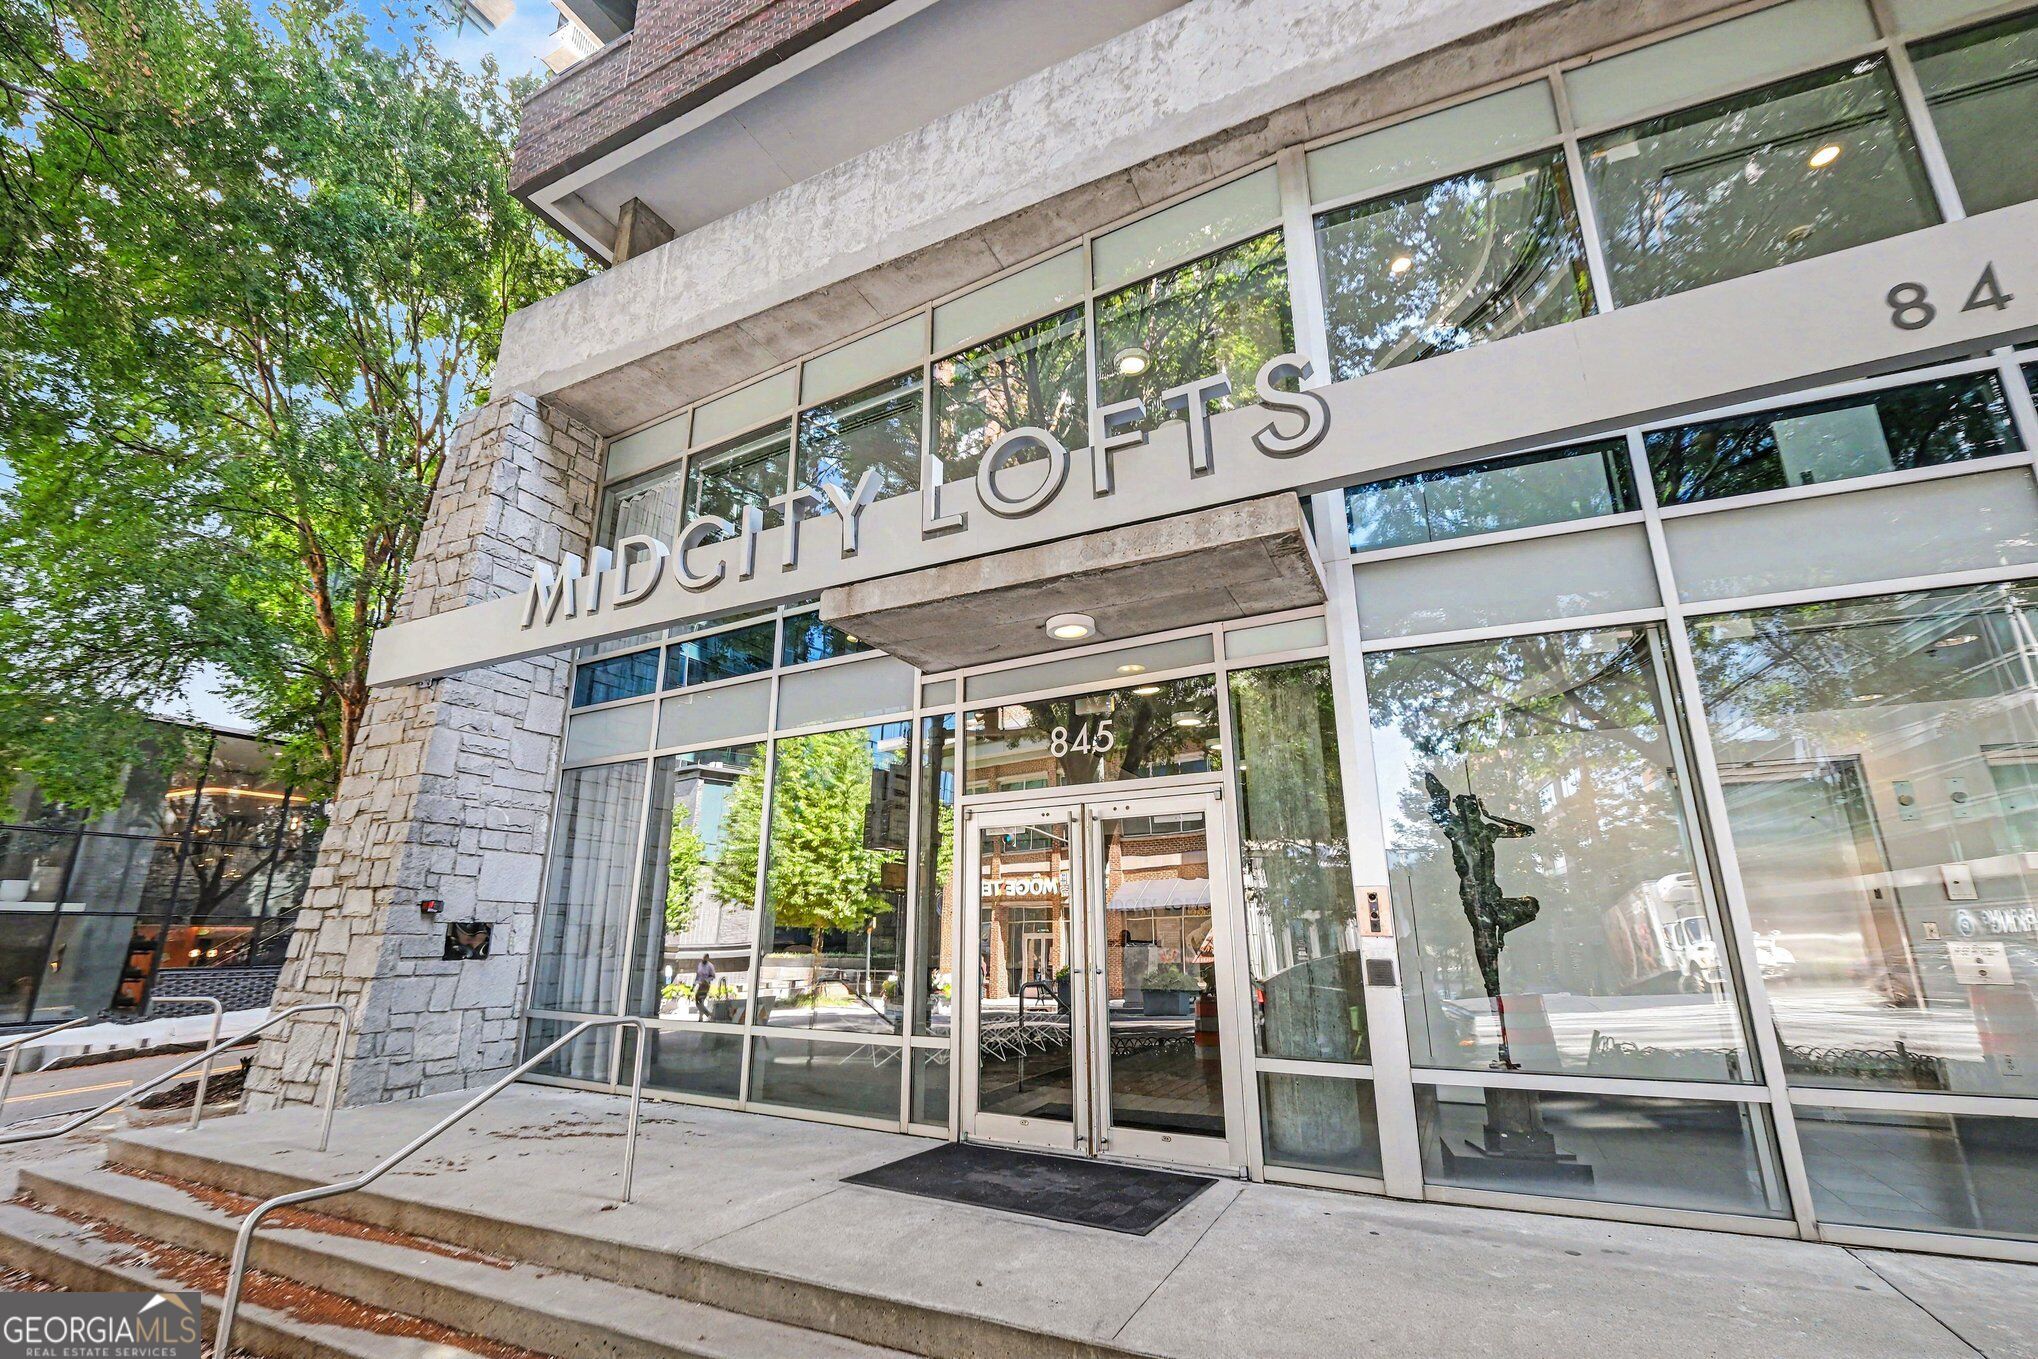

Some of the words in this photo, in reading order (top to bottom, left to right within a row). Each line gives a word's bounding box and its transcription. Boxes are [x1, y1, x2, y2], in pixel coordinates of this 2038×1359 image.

[520, 469, 885, 632] MIDCITY
[921, 352, 1331, 541] LOFTS
[1050, 719, 1115, 758] 845
